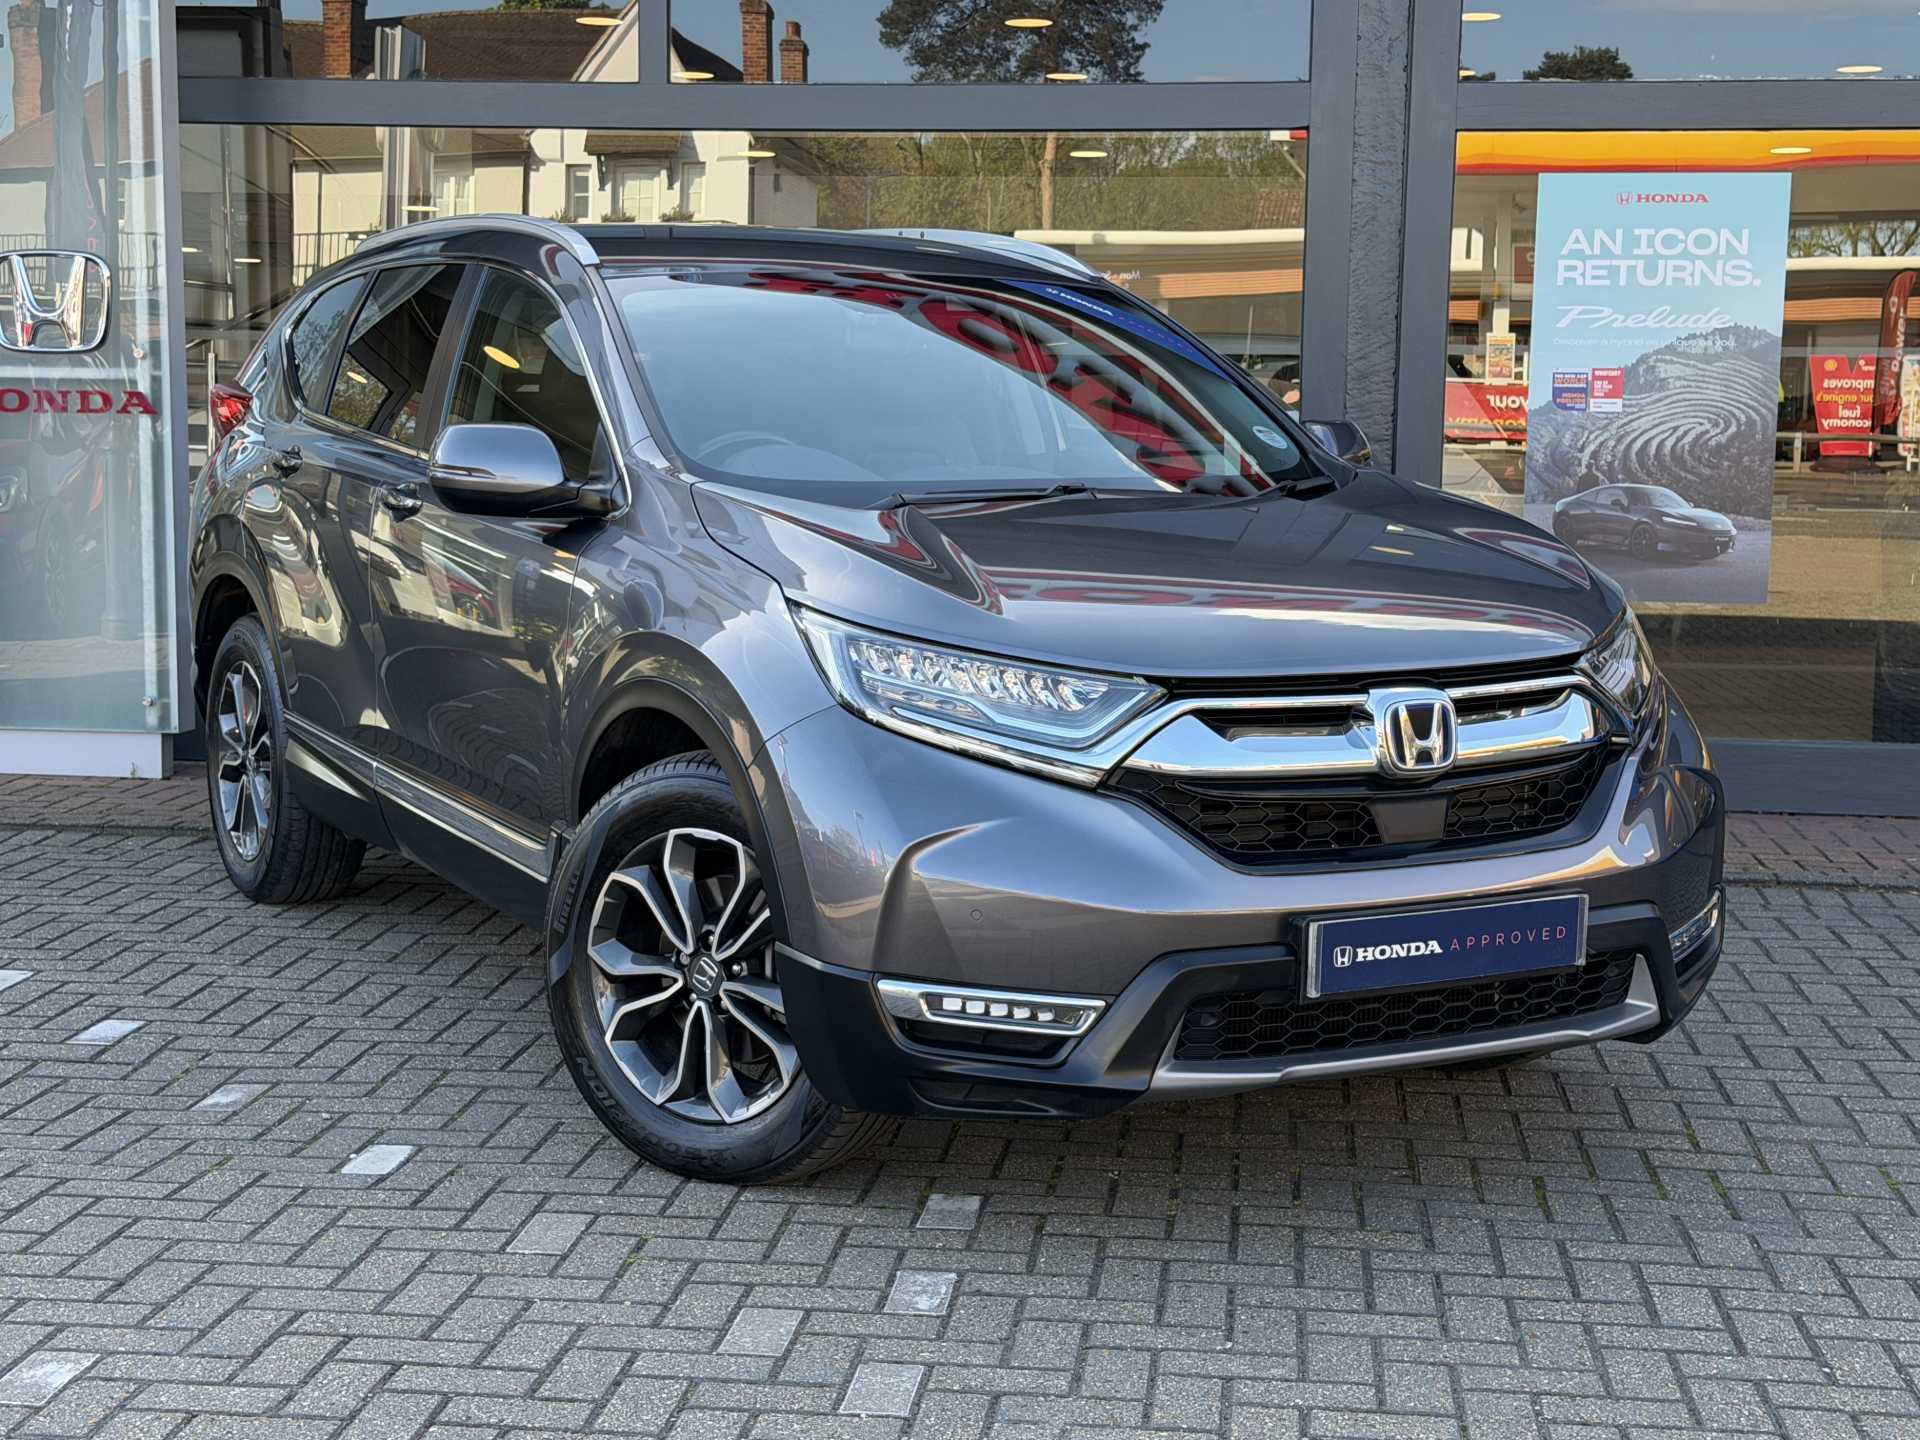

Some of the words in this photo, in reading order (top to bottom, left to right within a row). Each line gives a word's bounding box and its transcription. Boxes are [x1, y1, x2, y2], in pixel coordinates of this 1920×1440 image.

[1636, 193, 1709, 203] HONDA
[1560, 228, 1623, 255] AN
[1633, 228, 1749, 255] ICON
[1556, 259, 1762, 287] RETURNS.
[1555, 305, 1732, 328] Prelude
[1355, 940, 1443, 962] HONDA
[1450, 926, 1566, 952] APPROVED
